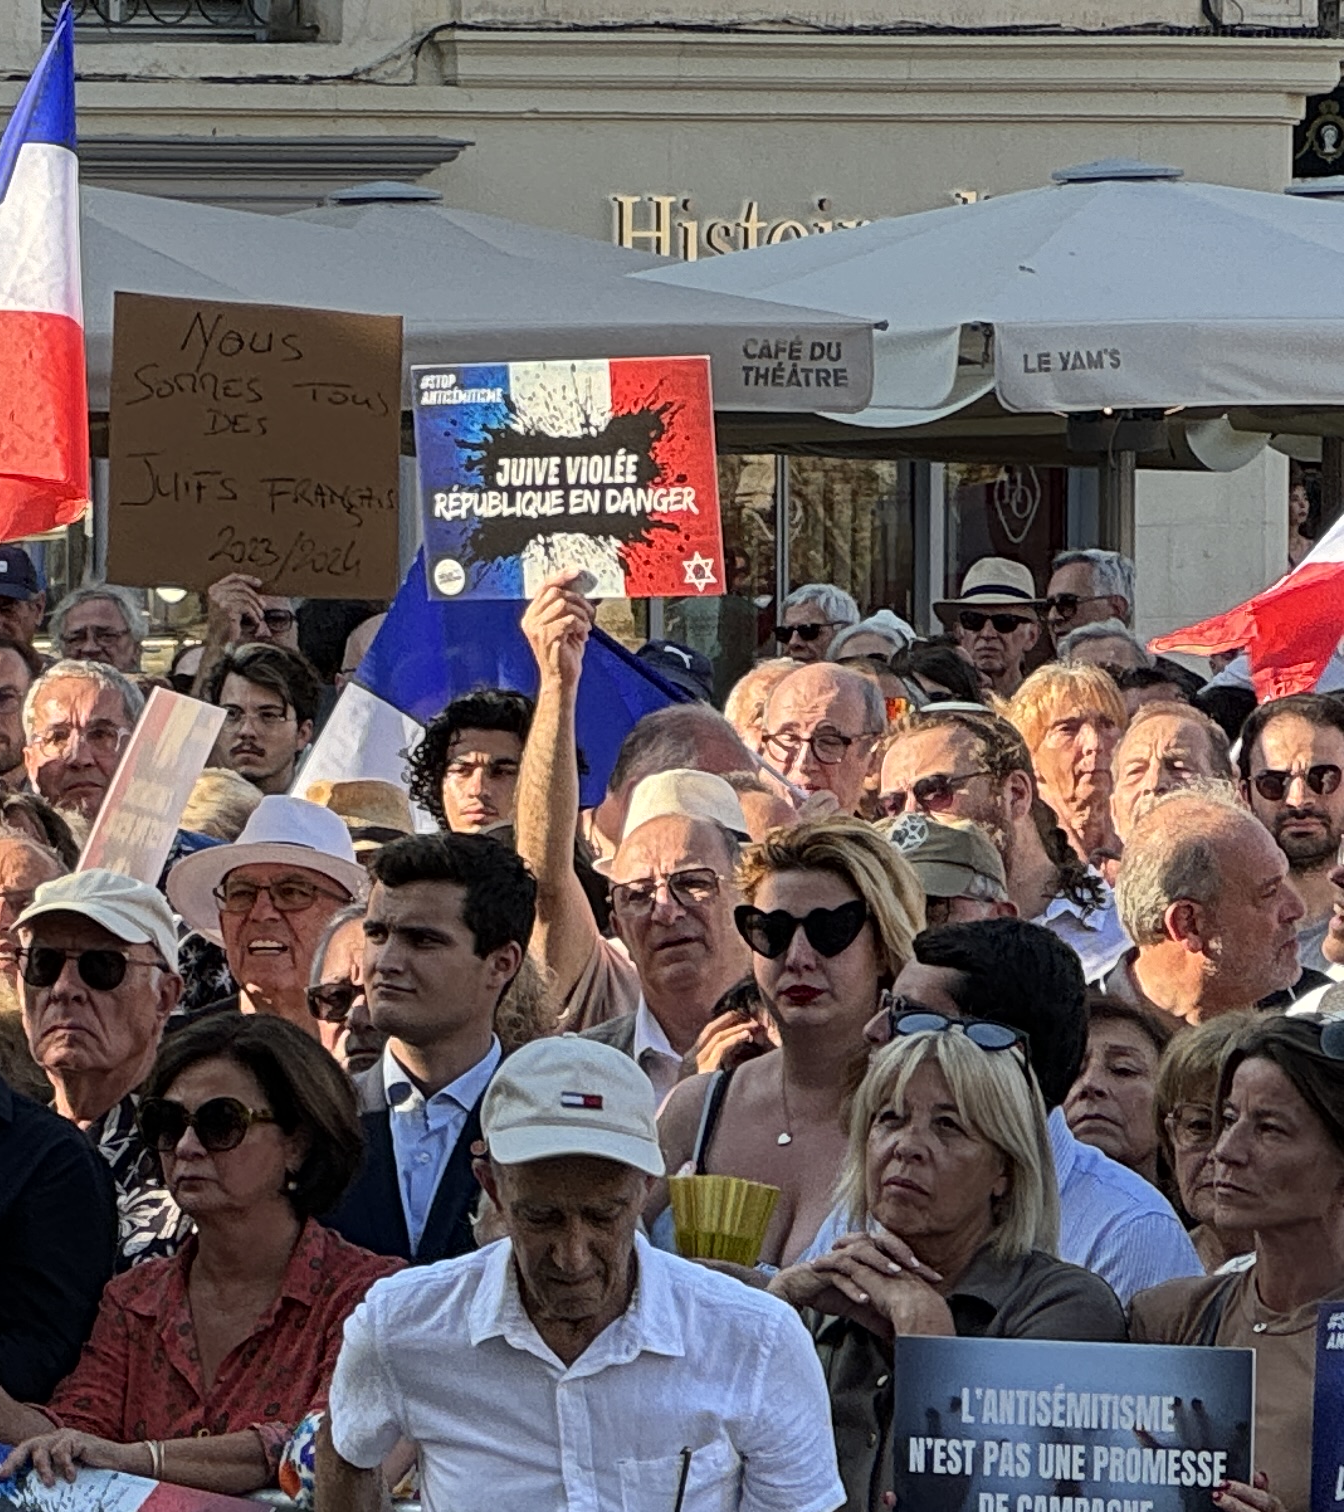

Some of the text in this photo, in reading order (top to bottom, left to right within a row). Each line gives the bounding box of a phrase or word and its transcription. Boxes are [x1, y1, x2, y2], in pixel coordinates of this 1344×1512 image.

[742, 335, 842, 361] CAFÉ DU
[1023, 347, 1121, 374] LE YAM'S
[741, 361, 849, 388] THÉÂTRE
[203, 408, 268, 436] DES
[119, 452, 237, 507] JUIFS
[496, 448, 639, 488] JUIVE VIOLÉE
[434, 484, 699, 521] RÉPUBLIQUE EN DANGER
[960, 1382, 1176, 1432] L'ANTISÉMITISME
[908, 1436, 1228, 1488] N'EST PAS UNE PROMESSE
